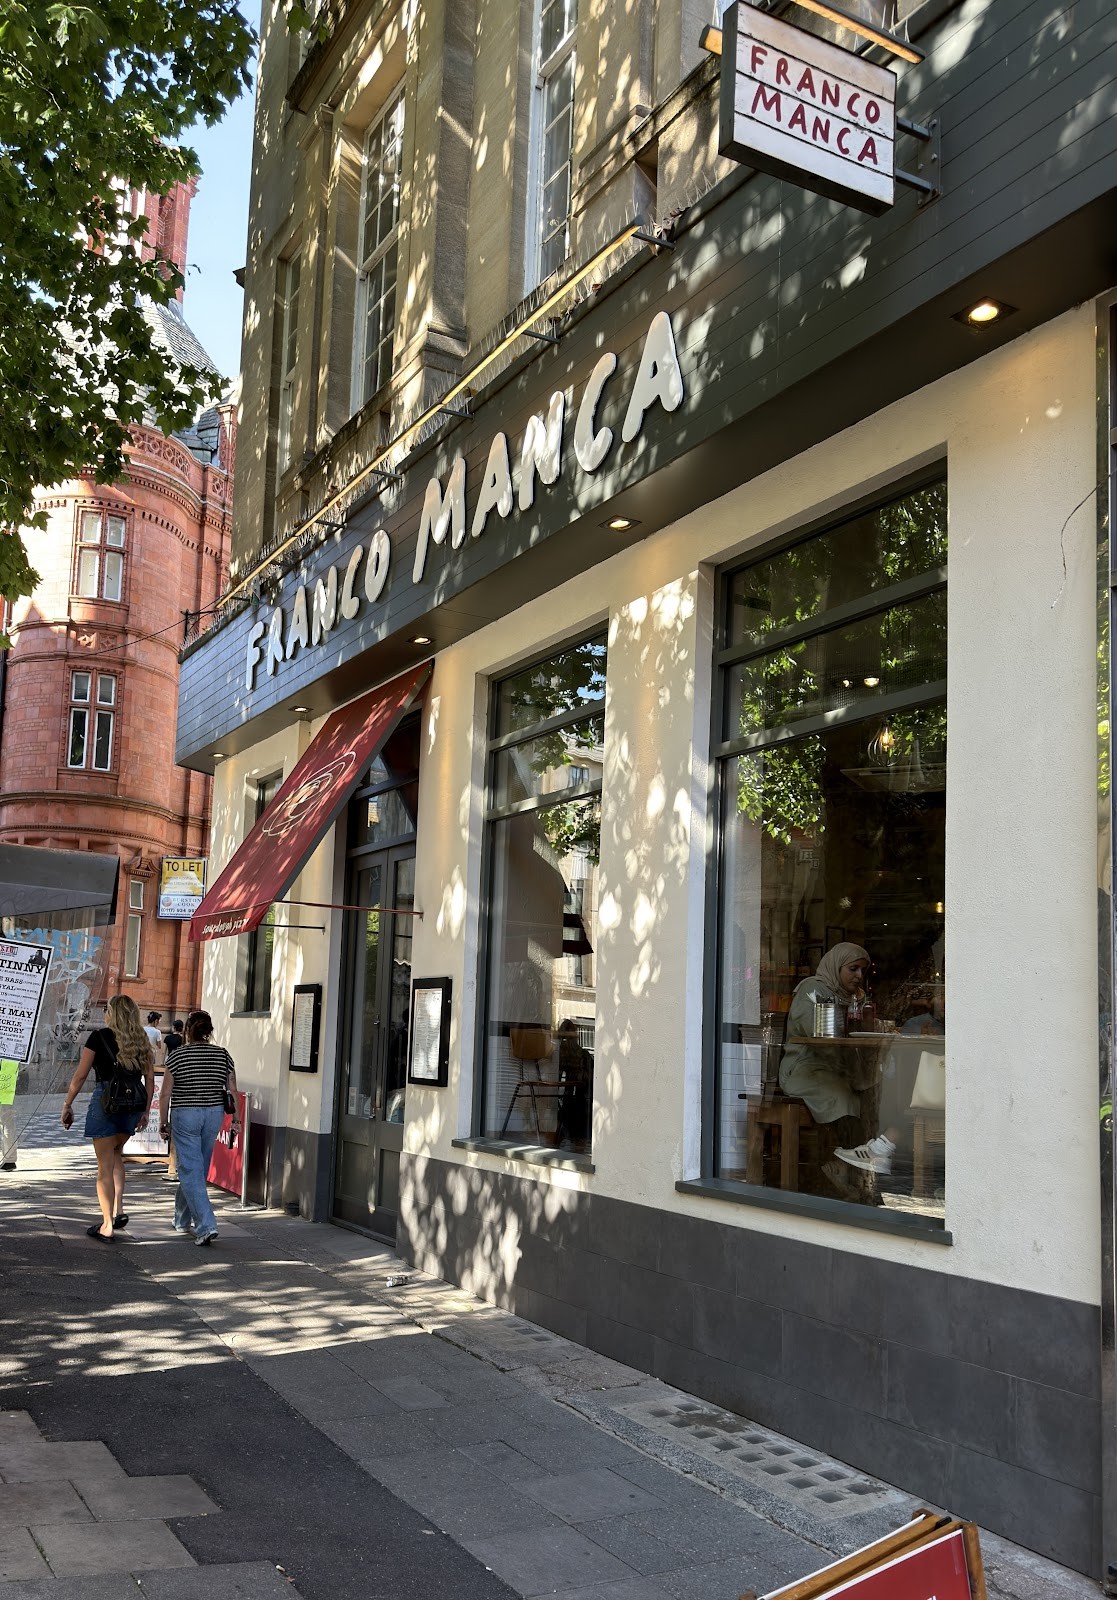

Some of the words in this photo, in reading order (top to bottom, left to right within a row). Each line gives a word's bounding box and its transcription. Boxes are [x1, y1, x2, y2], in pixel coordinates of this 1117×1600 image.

[750, 45, 881, 124] FRANCO
[751, 83, 878, 165] MANCA
[245, 529, 391, 691] FRANCO
[412, 311, 684, 585] MANCA
[165, 861, 180, 872] TO
[182, 861, 202, 872] LET
[0, 1018, 22, 1027] CKLE
[8, 1008, 34, 1018] MAY
